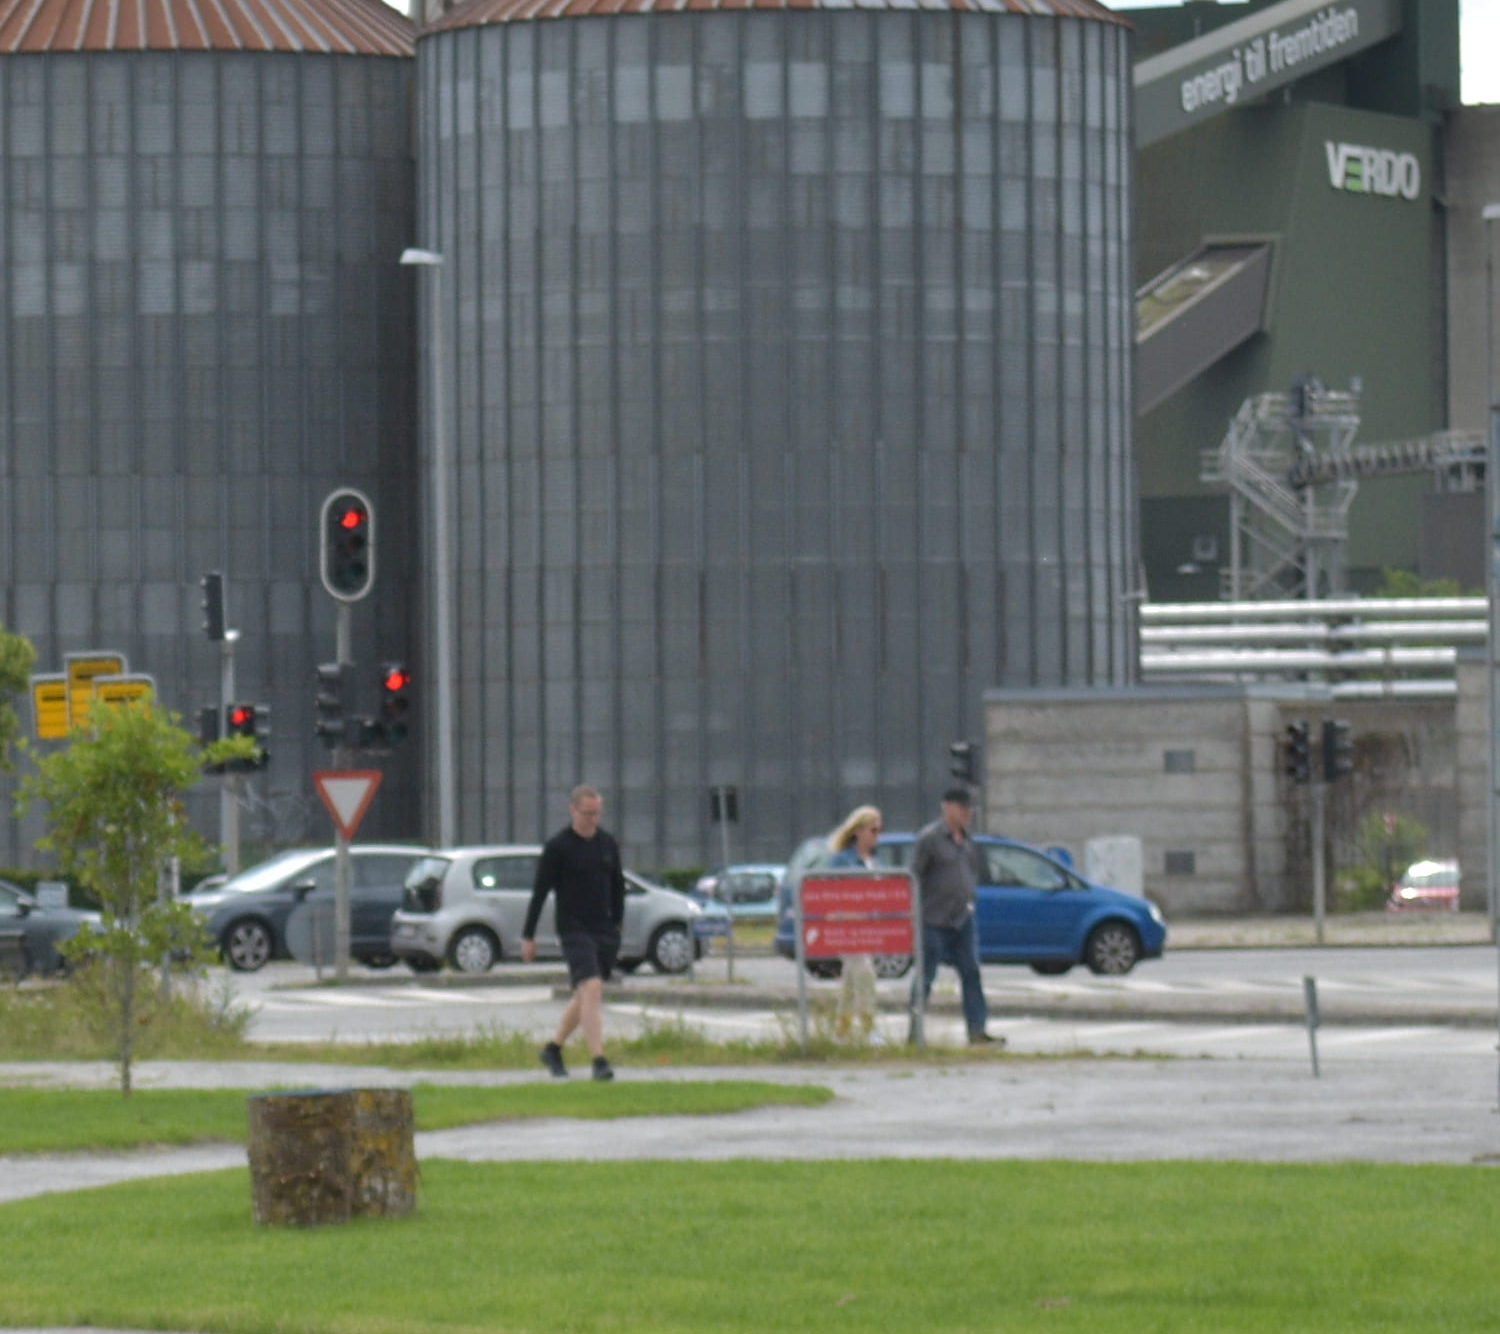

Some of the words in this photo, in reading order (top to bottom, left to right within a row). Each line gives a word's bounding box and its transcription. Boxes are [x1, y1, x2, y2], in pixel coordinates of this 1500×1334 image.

[1181, 48, 1243, 112] energi
[1245, 37, 1267, 83] til
[1268, 7, 1359, 72] fremtiden
[1325, 140, 1421, 201] VERDO
